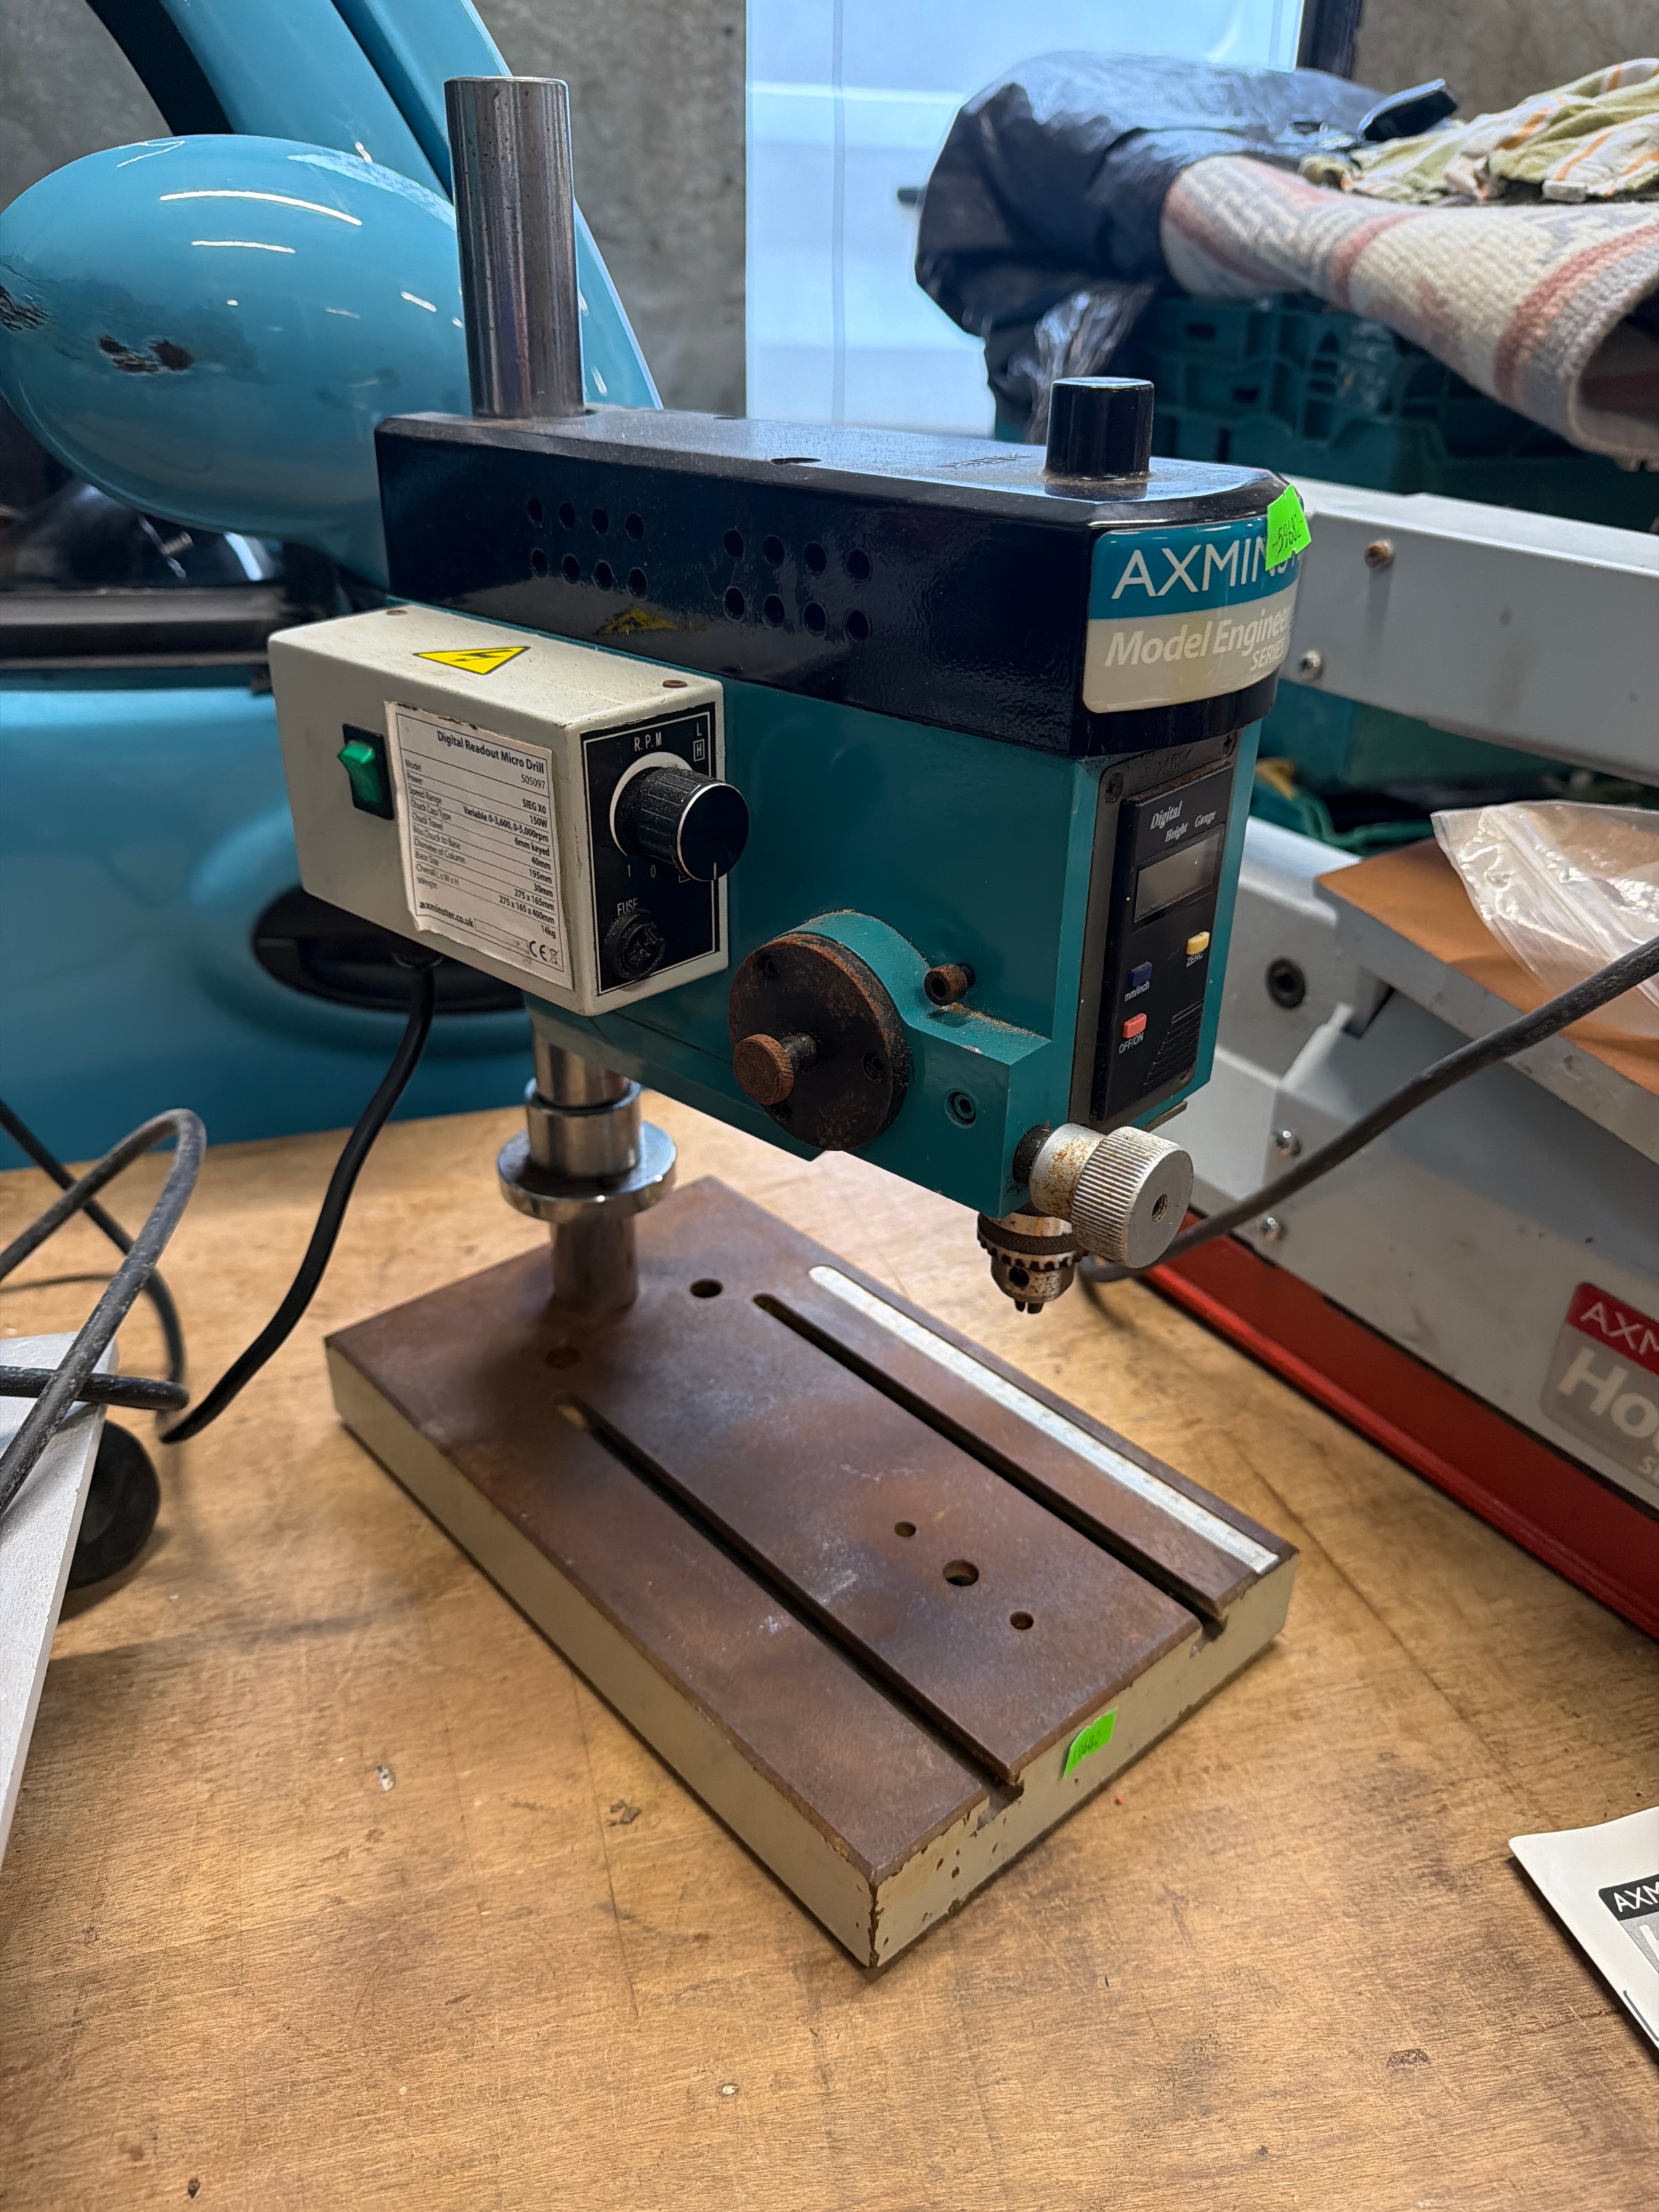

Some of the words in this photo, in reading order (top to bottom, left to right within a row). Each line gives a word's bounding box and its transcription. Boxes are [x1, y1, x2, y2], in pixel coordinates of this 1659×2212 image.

[1111, 535, 1297, 599] AXMIN
[1105, 621, 1212, 667] Model
[696, 722, 703, 737] L
[437, 731, 464, 749] Digital
[465, 739, 500, 761] Readout
[501, 751, 524, 768] Micro
[526, 759, 545, 774] Drill
[405, 759, 422, 771] Model
[407, 773, 423, 784] Power
[521, 774, 545, 790] 505097
[409, 786, 425, 798] Speed
[425, 792, 443, 807] Range
[411, 799, 427, 812] Chuck
[522, 798, 537, 810] SIEG
[412, 812, 427, 824] Chuck
[428, 818, 444, 830] Travel
[463, 805, 488, 822] Variable
[530, 815, 547, 829] 150W
[1150, 800, 1183, 830] Digital
[1164, 822, 1189, 844] Height
[1194, 811, 1216, 828] Gauge
[414, 838, 438, 853] Diameter
[445, 850, 467, 864] Column
[442, 836, 448, 845] to
[449, 838, 461, 850] Base
[514, 837, 531, 849] 6mm
[531, 842, 550, 857] keyed
[415, 850, 429, 861] Base
[532, 856, 551, 871] 40mm
[417, 876, 438, 889] Weight
[529, 868, 552, 884] 195mm
[534, 883, 553, 898] 30mm
[514, 889, 526, 900] 275
[532, 896, 555, 911] 165mm
[617, 898, 638, 917] FUSE
[419, 901, 474, 928] axminster.co.uk
[499, 895, 511, 907] 275
[516, 901, 527, 913] 165
[532, 909, 555, 925] 400mm
[541, 924, 556, 939] 14kg
[1124, 980, 1150, 1003] mm/inch
[1119, 1033, 1145, 1054] OFF/ON
[1557, 1345, 1659, 1451] Ho
